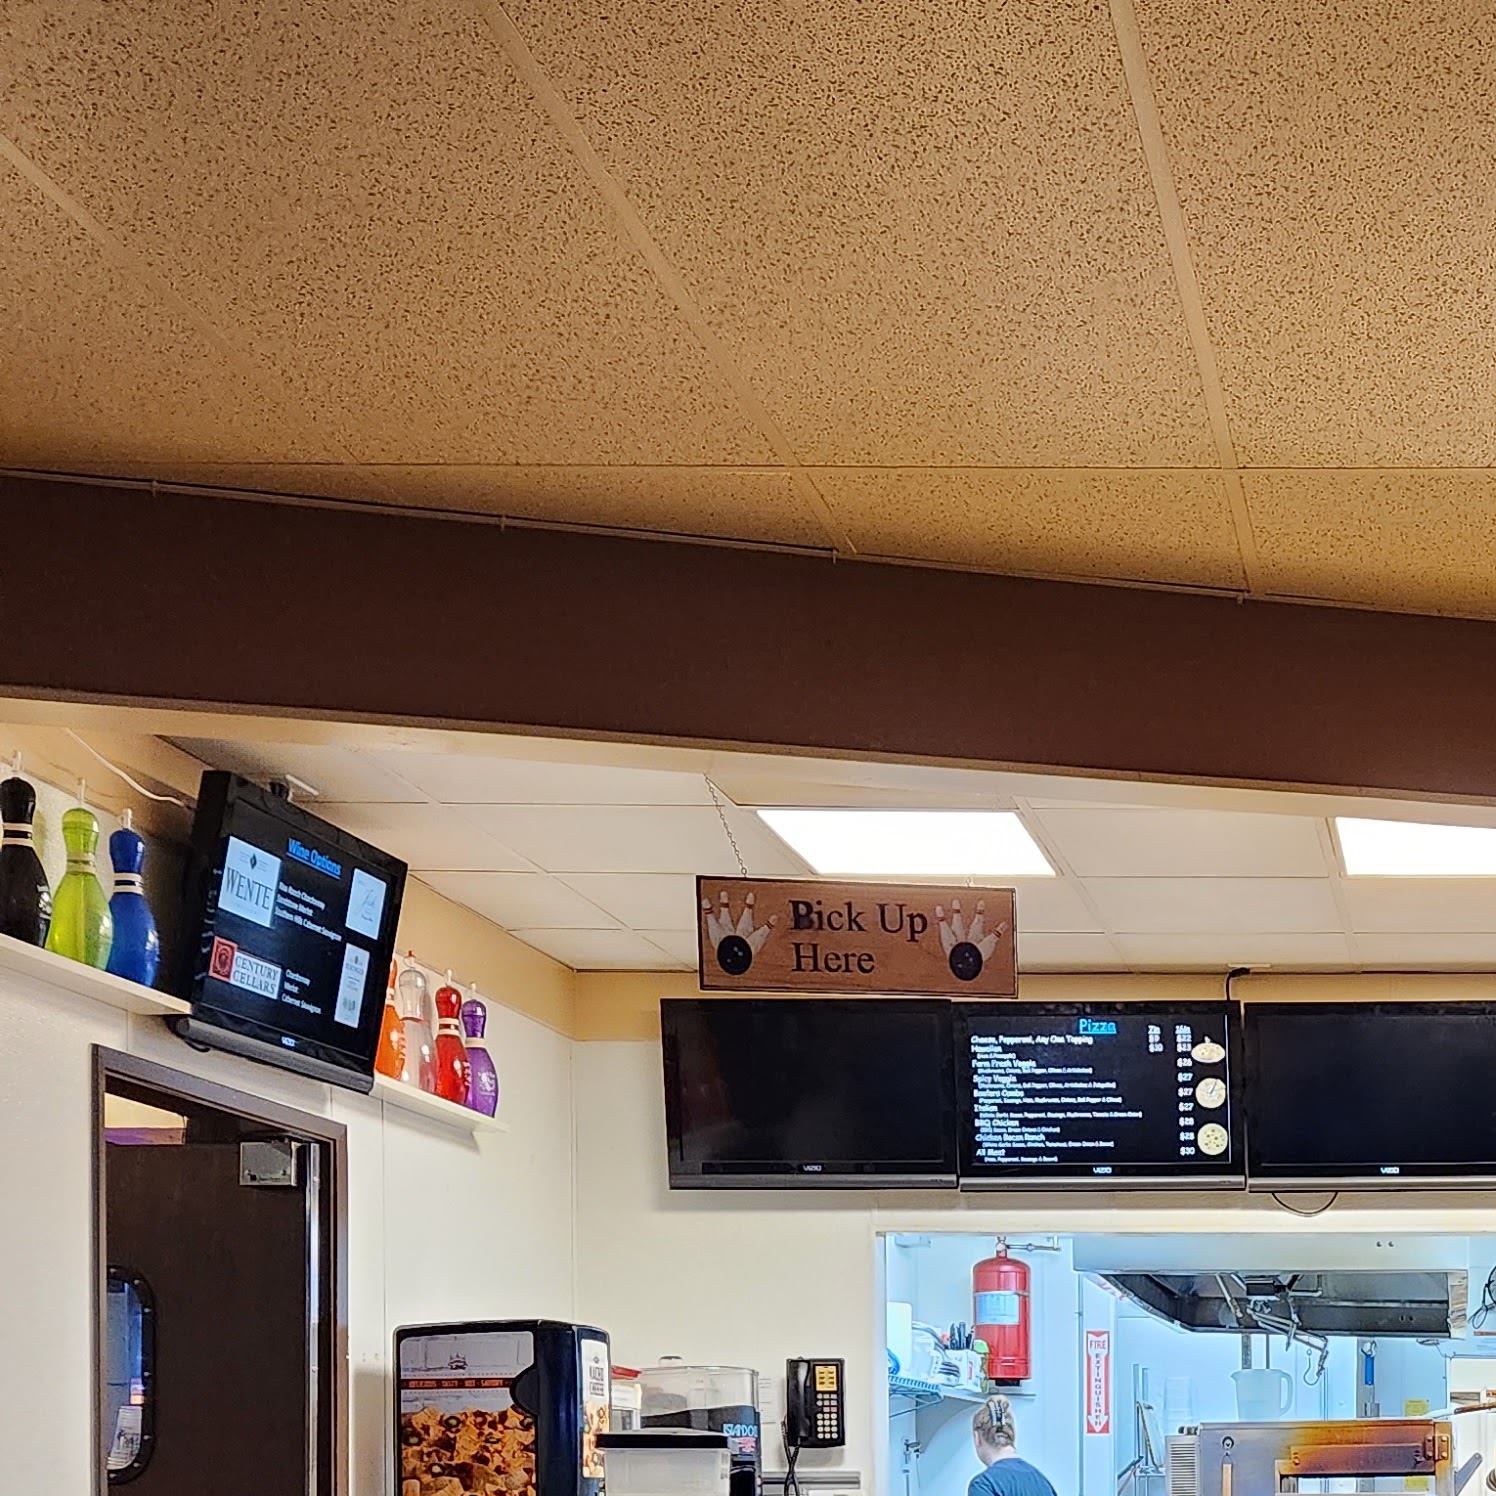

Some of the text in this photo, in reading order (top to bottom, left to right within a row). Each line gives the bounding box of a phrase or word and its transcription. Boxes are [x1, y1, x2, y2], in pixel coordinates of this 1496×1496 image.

[288, 838, 342, 876] Wine Options
[226, 867, 273, 910] WENTE
[876, 903, 928, 942] Up
[235, 955, 279, 982] CENTURY
[791, 942, 875, 974] Here
[233, 969, 276, 995] CELLARS
[1079, 1018, 1117, 1033] Pizza
[1066, 1035, 1094, 1045] Topping
[992, 1119, 1020, 1127] Chicken
[1090, 1340, 1106, 1349] FIRE
[1094, 1353, 1102, 1426] EXTINGUISHER
